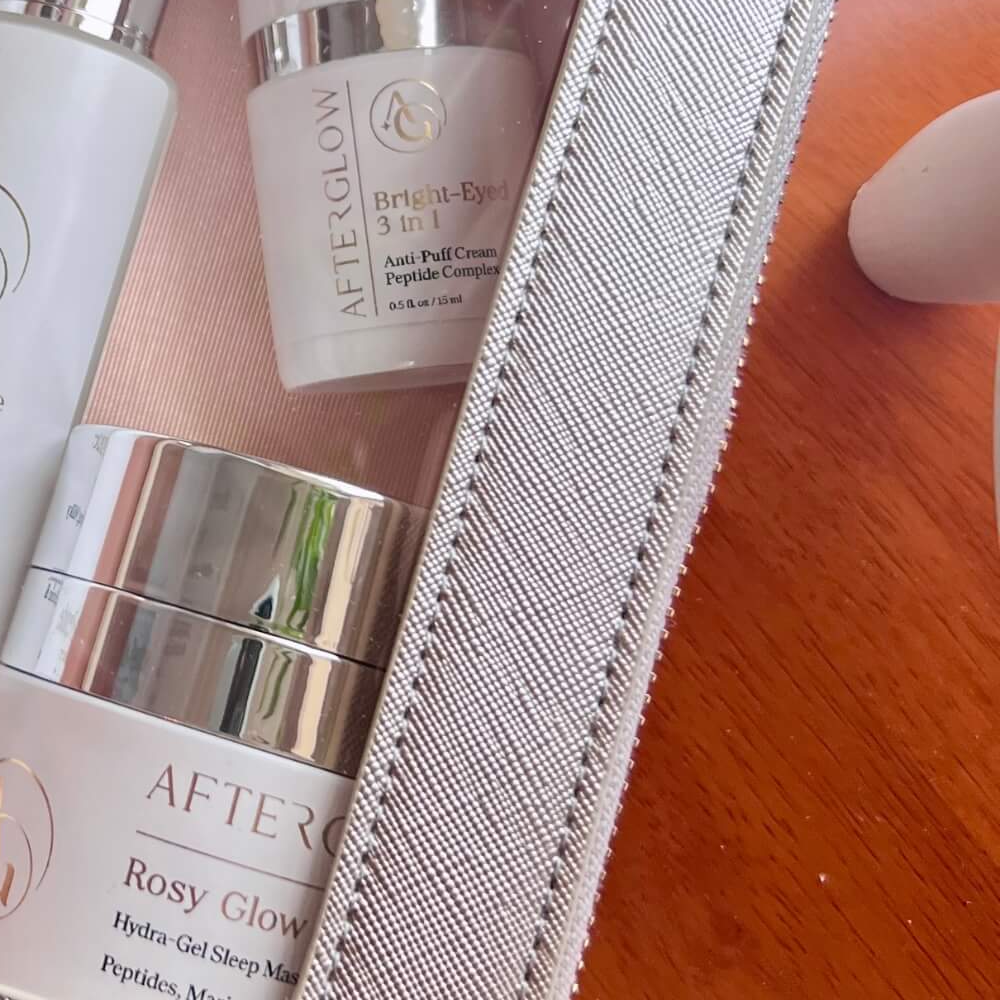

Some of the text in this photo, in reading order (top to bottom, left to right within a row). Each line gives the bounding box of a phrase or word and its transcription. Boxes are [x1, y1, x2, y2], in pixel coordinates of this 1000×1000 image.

[312, 88, 368, 319] AFTERGLOW
[376, 209, 441, 237] 3 in 1
[384, 245, 498, 269] Anti-Puff Cream
[385, 262, 501, 288] Peptide Complex
[449, 293, 463, 305] ml
[123, 856, 309, 940] Rosy Glow
[112, 910, 209, 959] Hydra-Gel
[209, 945, 260, 978] Sleep
[100, 953, 182, 1000] Peptides,
